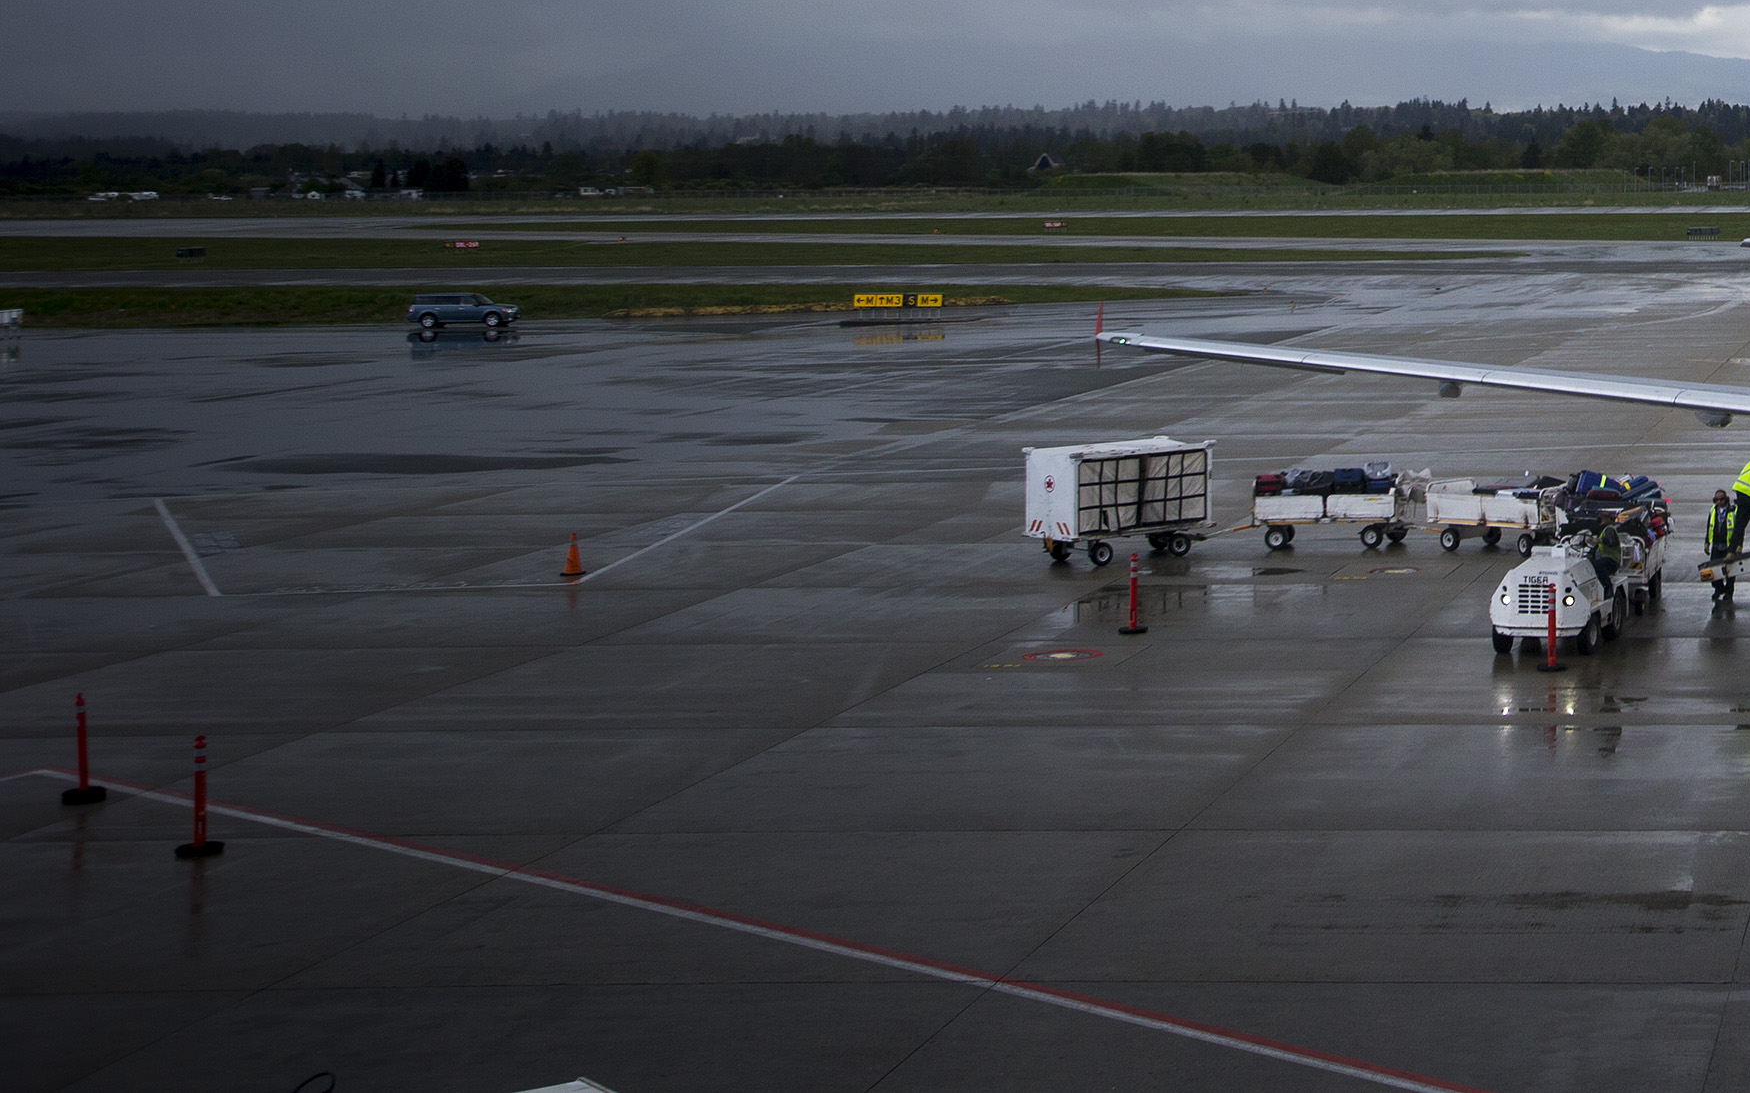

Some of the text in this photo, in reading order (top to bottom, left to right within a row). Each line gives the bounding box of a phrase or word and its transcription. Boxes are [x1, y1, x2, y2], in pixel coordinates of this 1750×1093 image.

[866, 296, 930, 306] M M3 S M
[1523, 576, 1549, 584] TIGER
